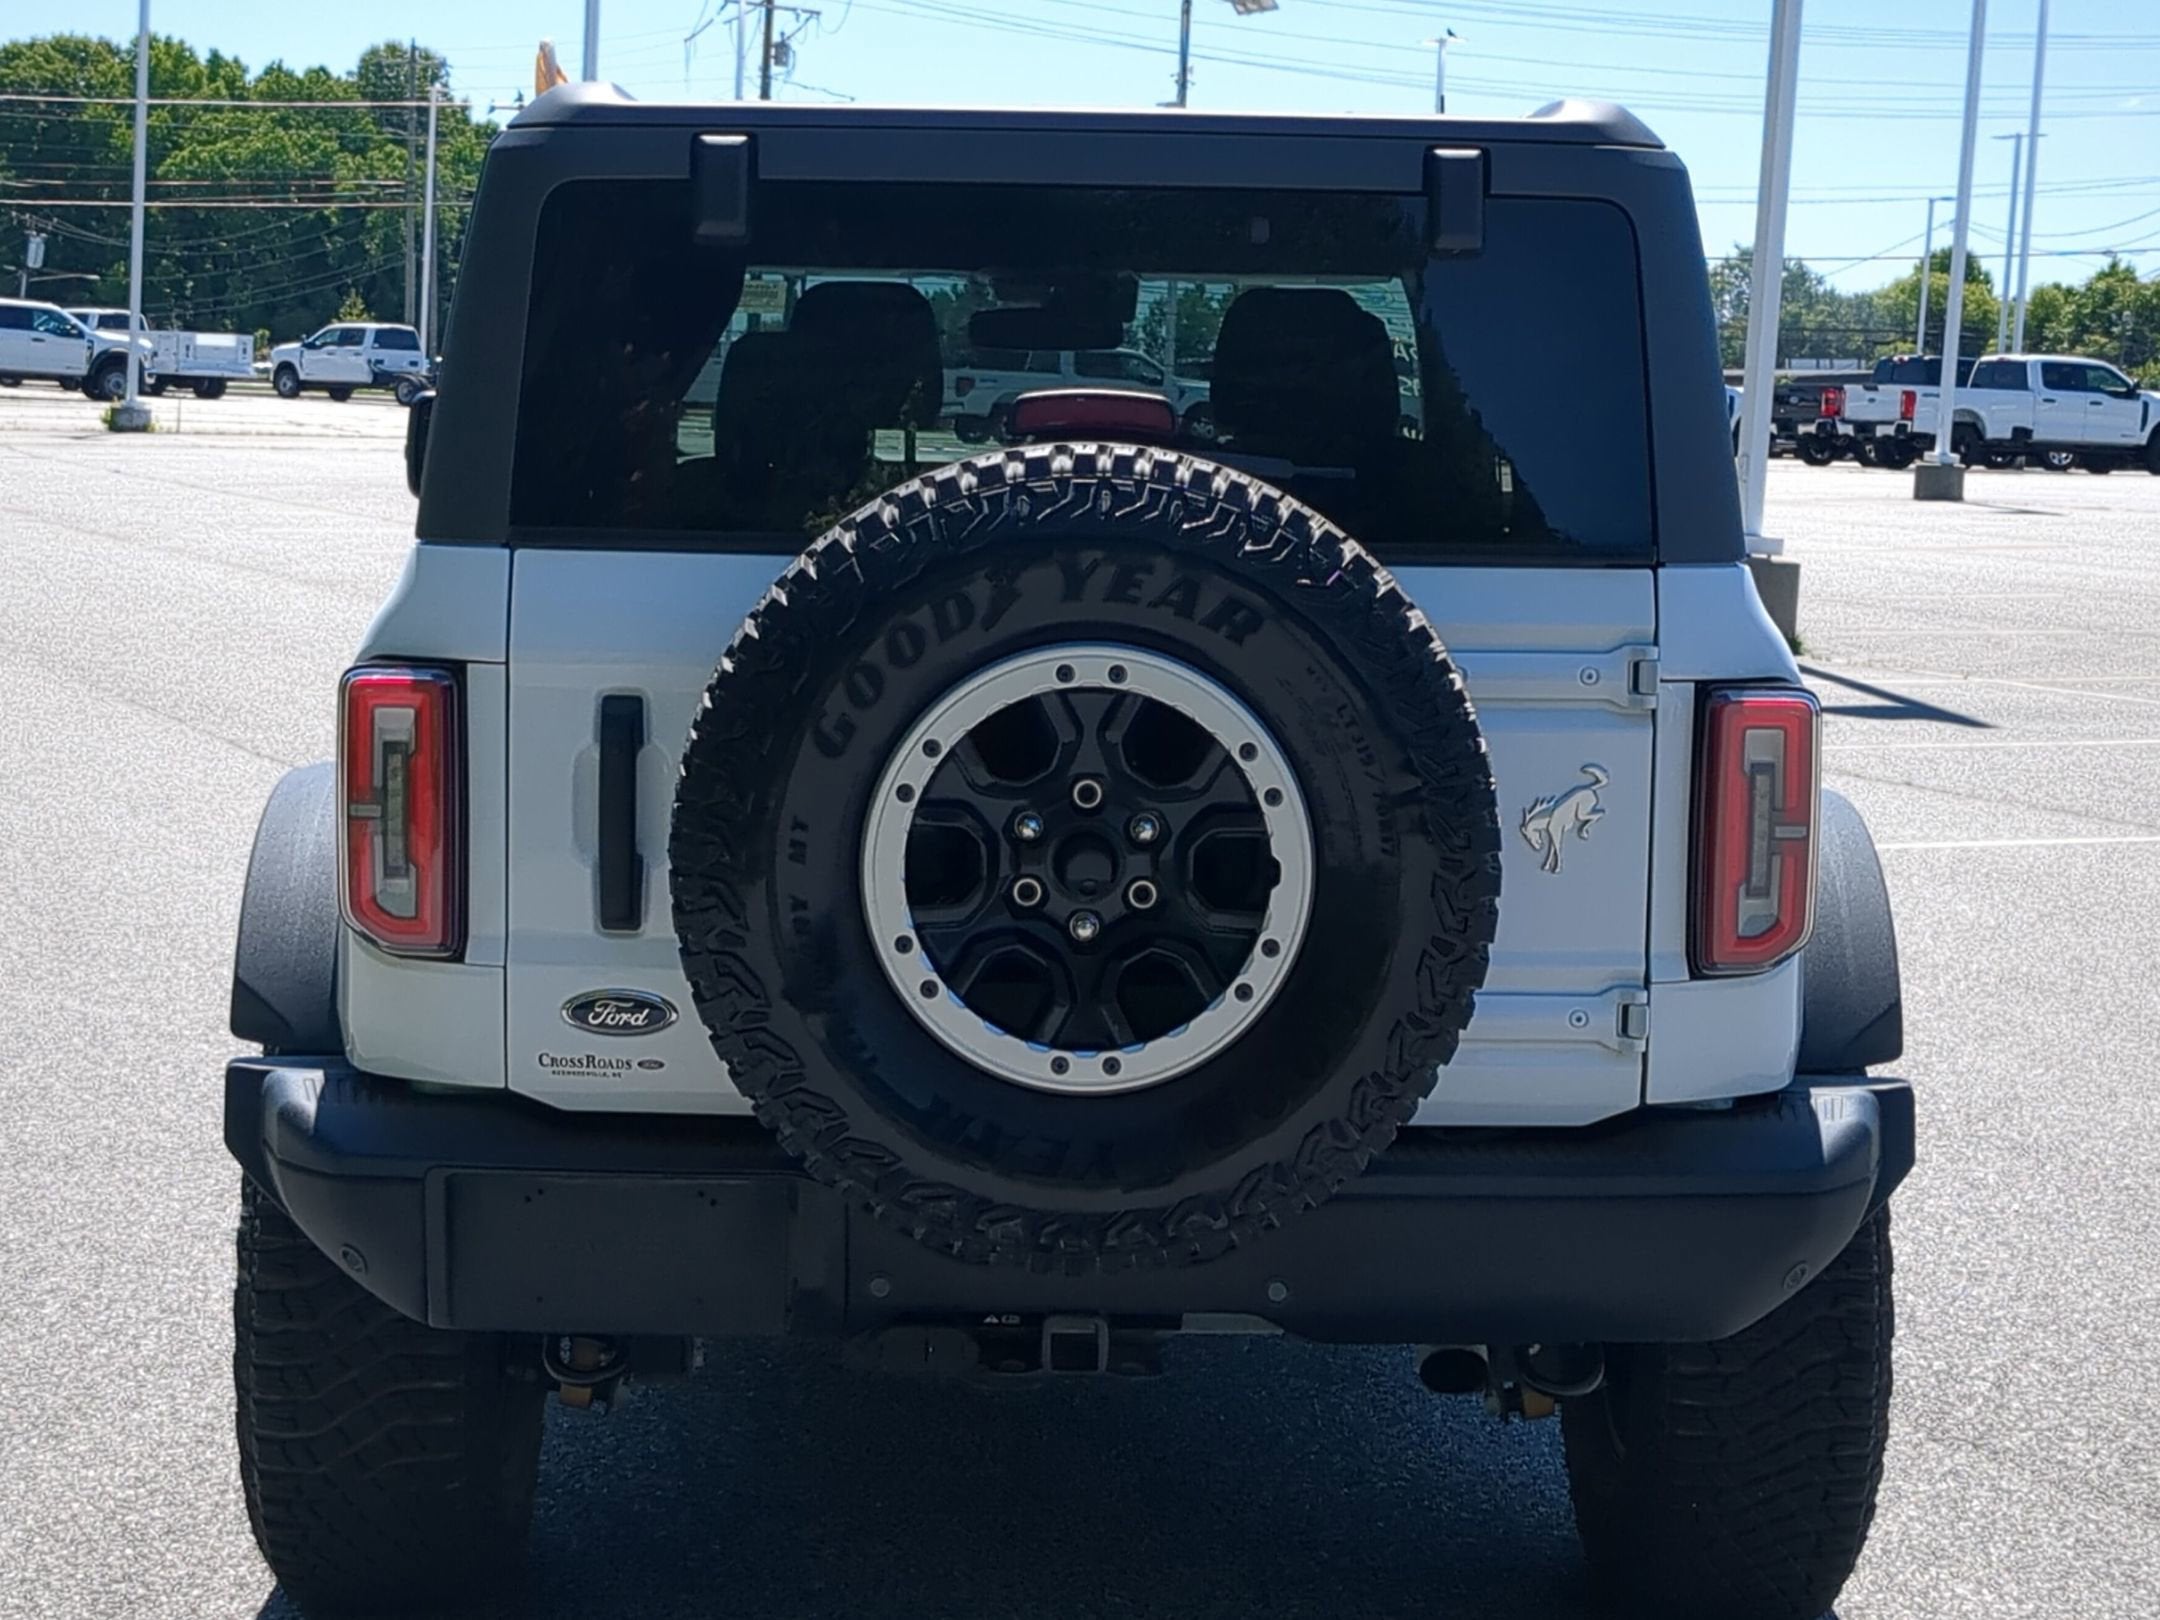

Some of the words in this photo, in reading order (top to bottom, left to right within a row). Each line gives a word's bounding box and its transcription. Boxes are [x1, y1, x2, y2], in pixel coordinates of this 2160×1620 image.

[811, 591, 976, 758] GOOD
[1056, 553, 1266, 647] YEAR
[588, 1000, 650, 1026] Ford
